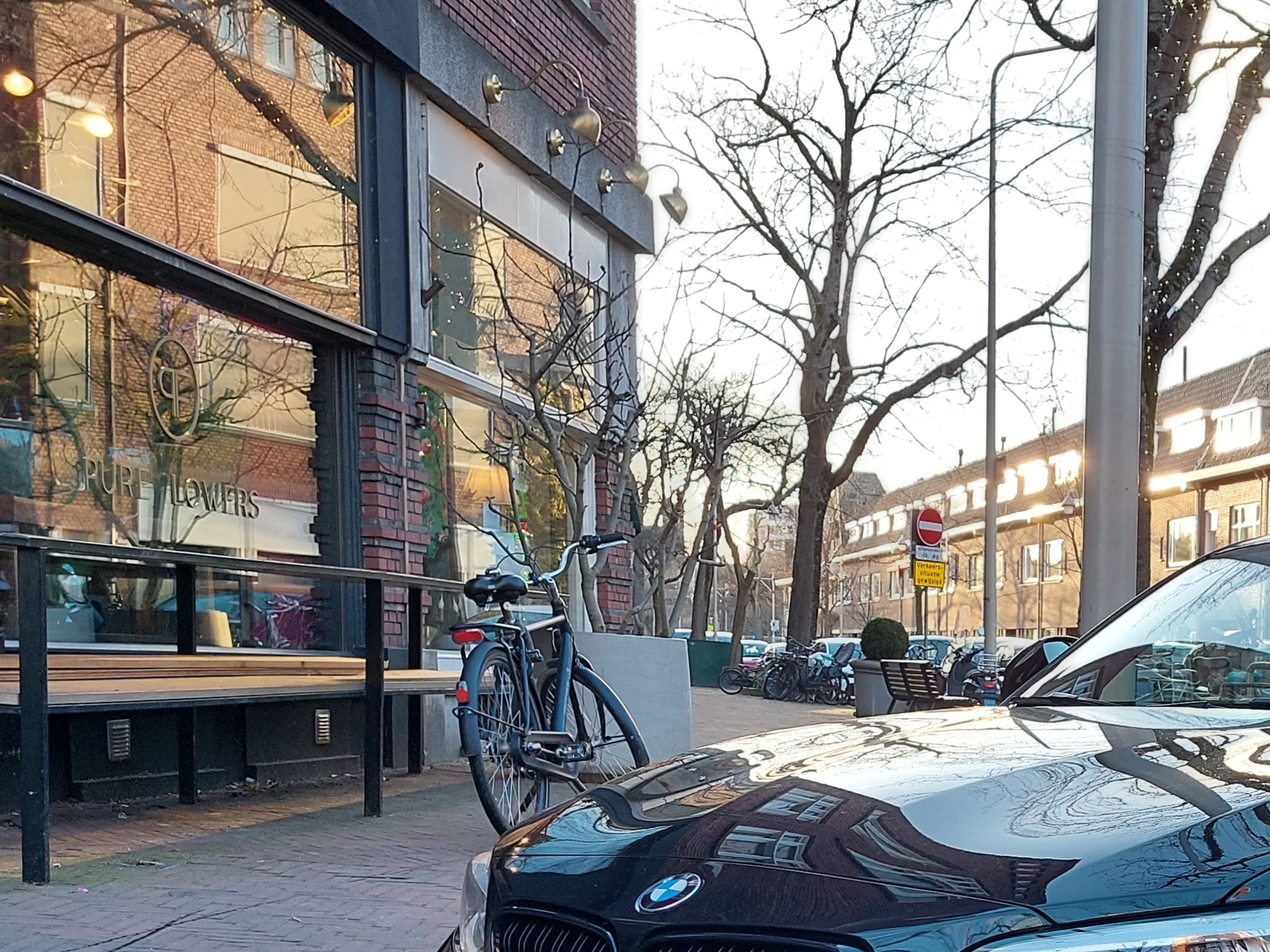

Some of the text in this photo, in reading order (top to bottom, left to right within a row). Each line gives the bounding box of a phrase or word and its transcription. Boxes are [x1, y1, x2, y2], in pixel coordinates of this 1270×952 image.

[163, 470, 260, 519] LOWERS
[917, 562, 944, 571] Verkeers-
[920, 570, 940, 578] situatie
